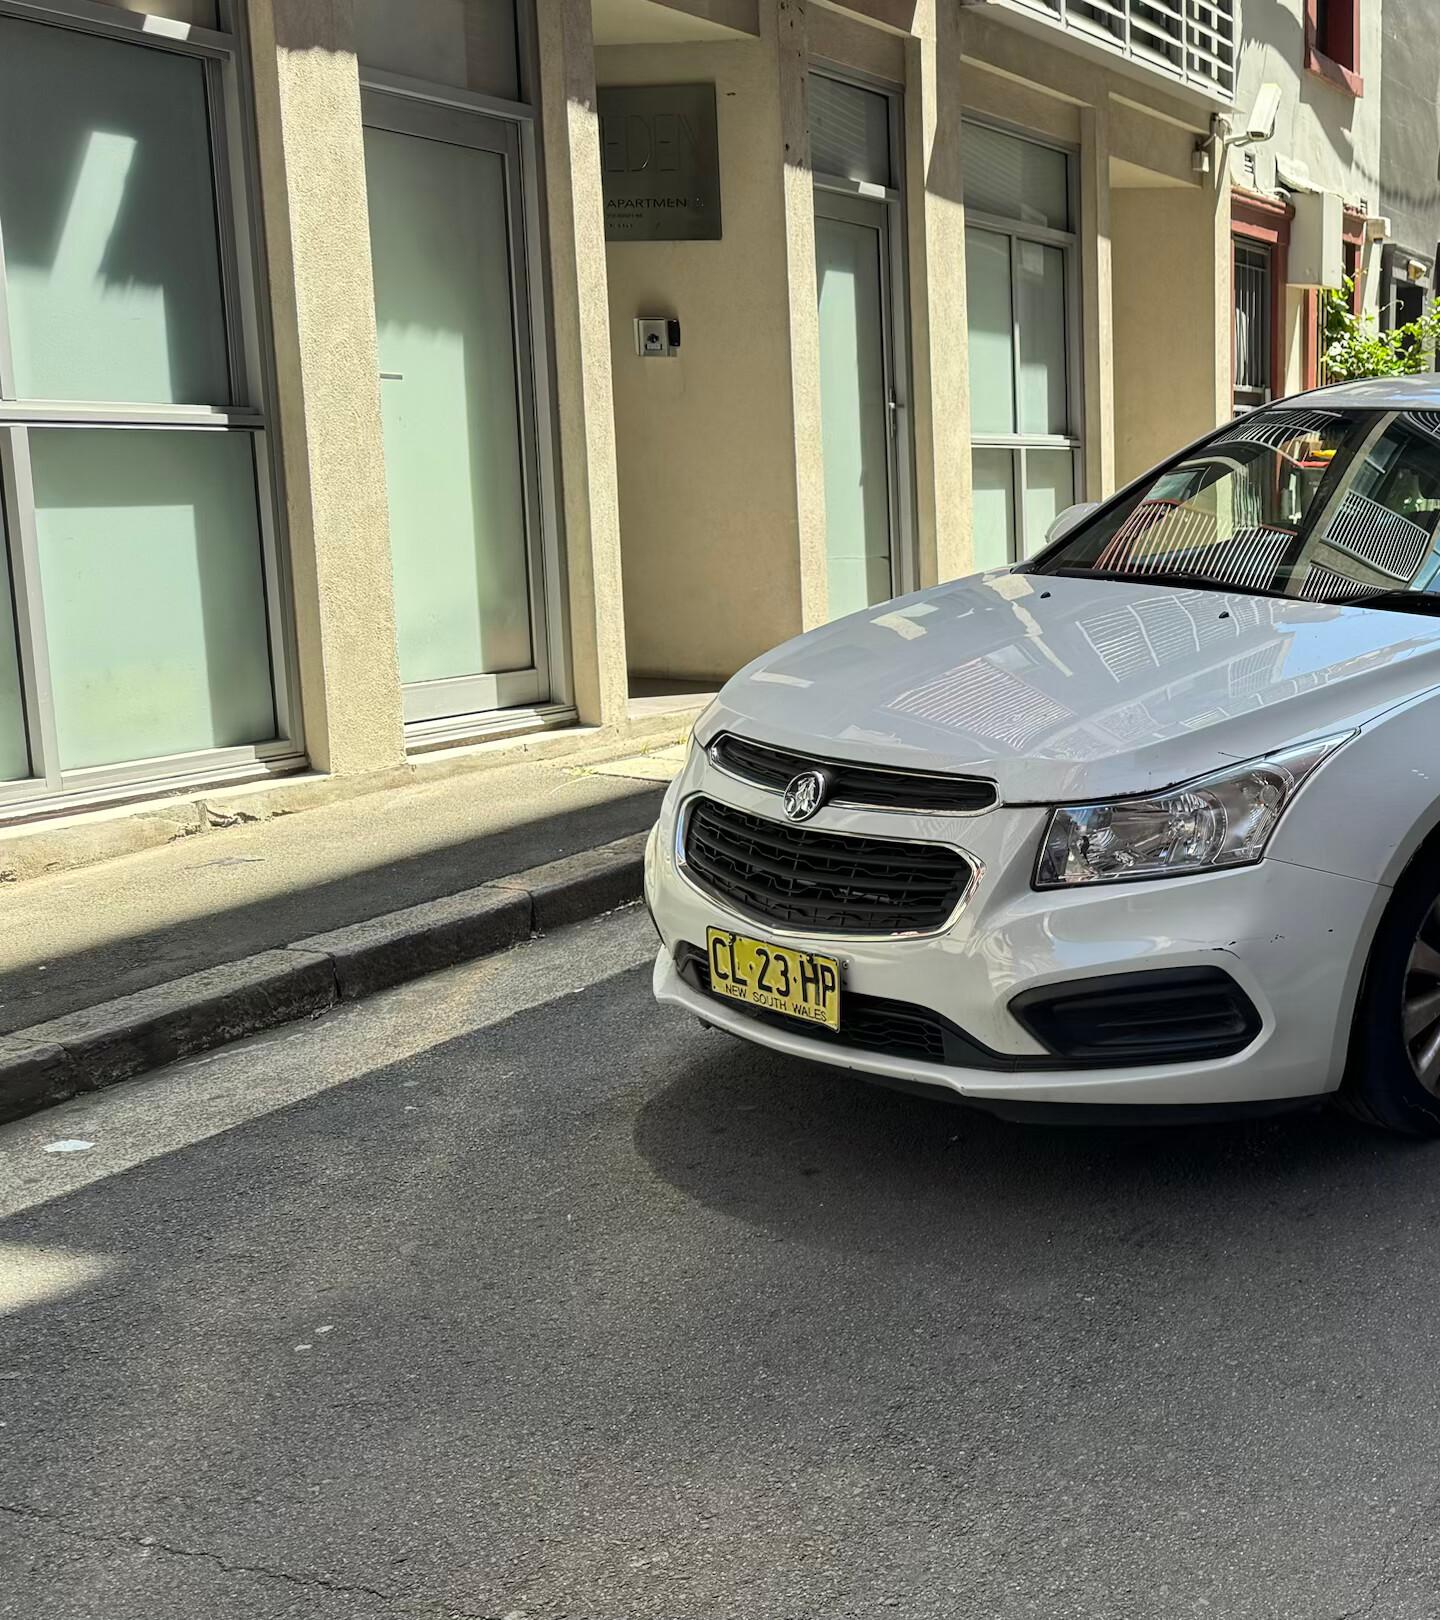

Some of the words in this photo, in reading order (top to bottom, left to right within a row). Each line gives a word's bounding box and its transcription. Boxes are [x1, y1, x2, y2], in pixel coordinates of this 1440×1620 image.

[607, 197, 704, 208] APARTMEN
[725, 983, 747, 998] NEW
[752, 992, 787, 1010] SOUTH
[792, 1005, 827, 1022] WALES
